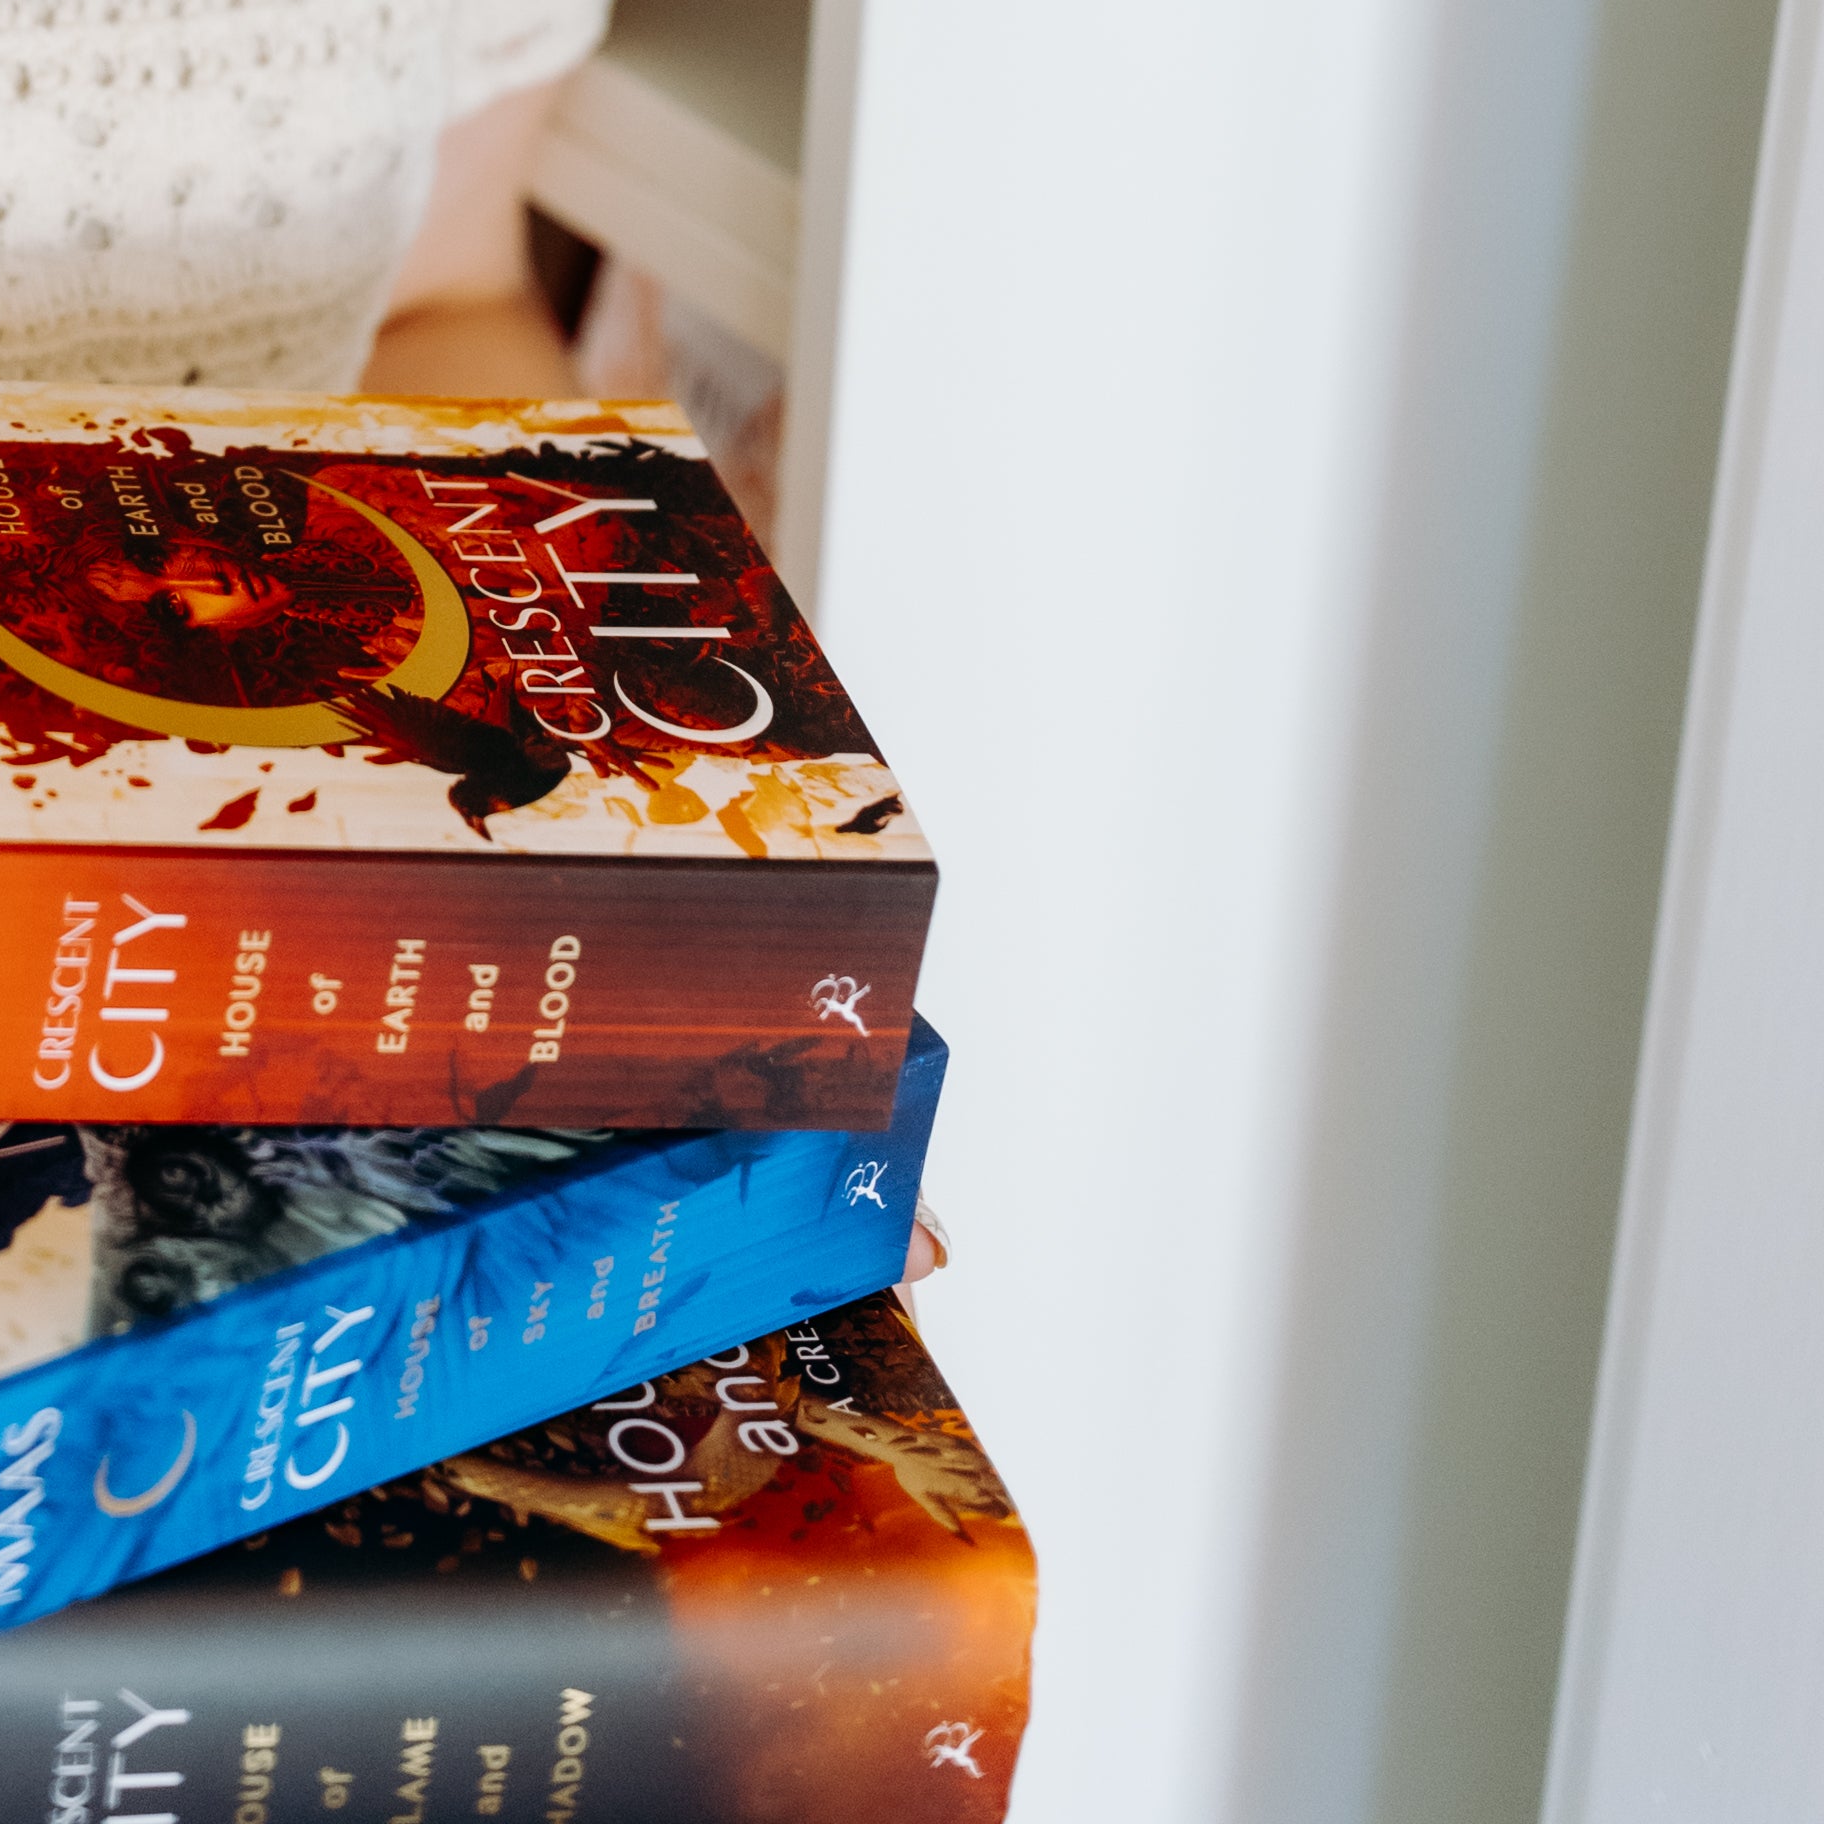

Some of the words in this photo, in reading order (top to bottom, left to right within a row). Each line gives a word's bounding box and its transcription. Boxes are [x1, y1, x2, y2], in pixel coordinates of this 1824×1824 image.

[47, 484, 84, 510] of
[106, 465, 160, 536] EARTH
[175, 481, 219, 524] and
[233, 465, 293, 545] BLOOD
[416, 468, 612, 741] CRESCENT
[506, 470, 774, 743] CITY
[32, 893, 100, 1091] CRESCENT
[88, 892, 188, 1092] CITY
[218, 929, 271, 1057] HOUSE
[308, 972, 344, 1015] of
[375, 939, 427, 1054] EARTH
[464, 963, 500, 1033] and
[528, 934, 582, 1063] BLOOD
[587, 1256, 614, 1320] and
[633, 1201, 680, 1336] BREATH
[469, 1315, 492, 1352] of
[522, 1281, 554, 1344] SKY
[285, 1304, 375, 1490] CITY
[394, 1295, 441, 1420] HOUSE
[241, 1322, 306, 1511] CRESCENT
[827, 1396, 862, 1417] A
[320, 1767, 353, 1809] of
[477, 1745, 511, 1815] and
